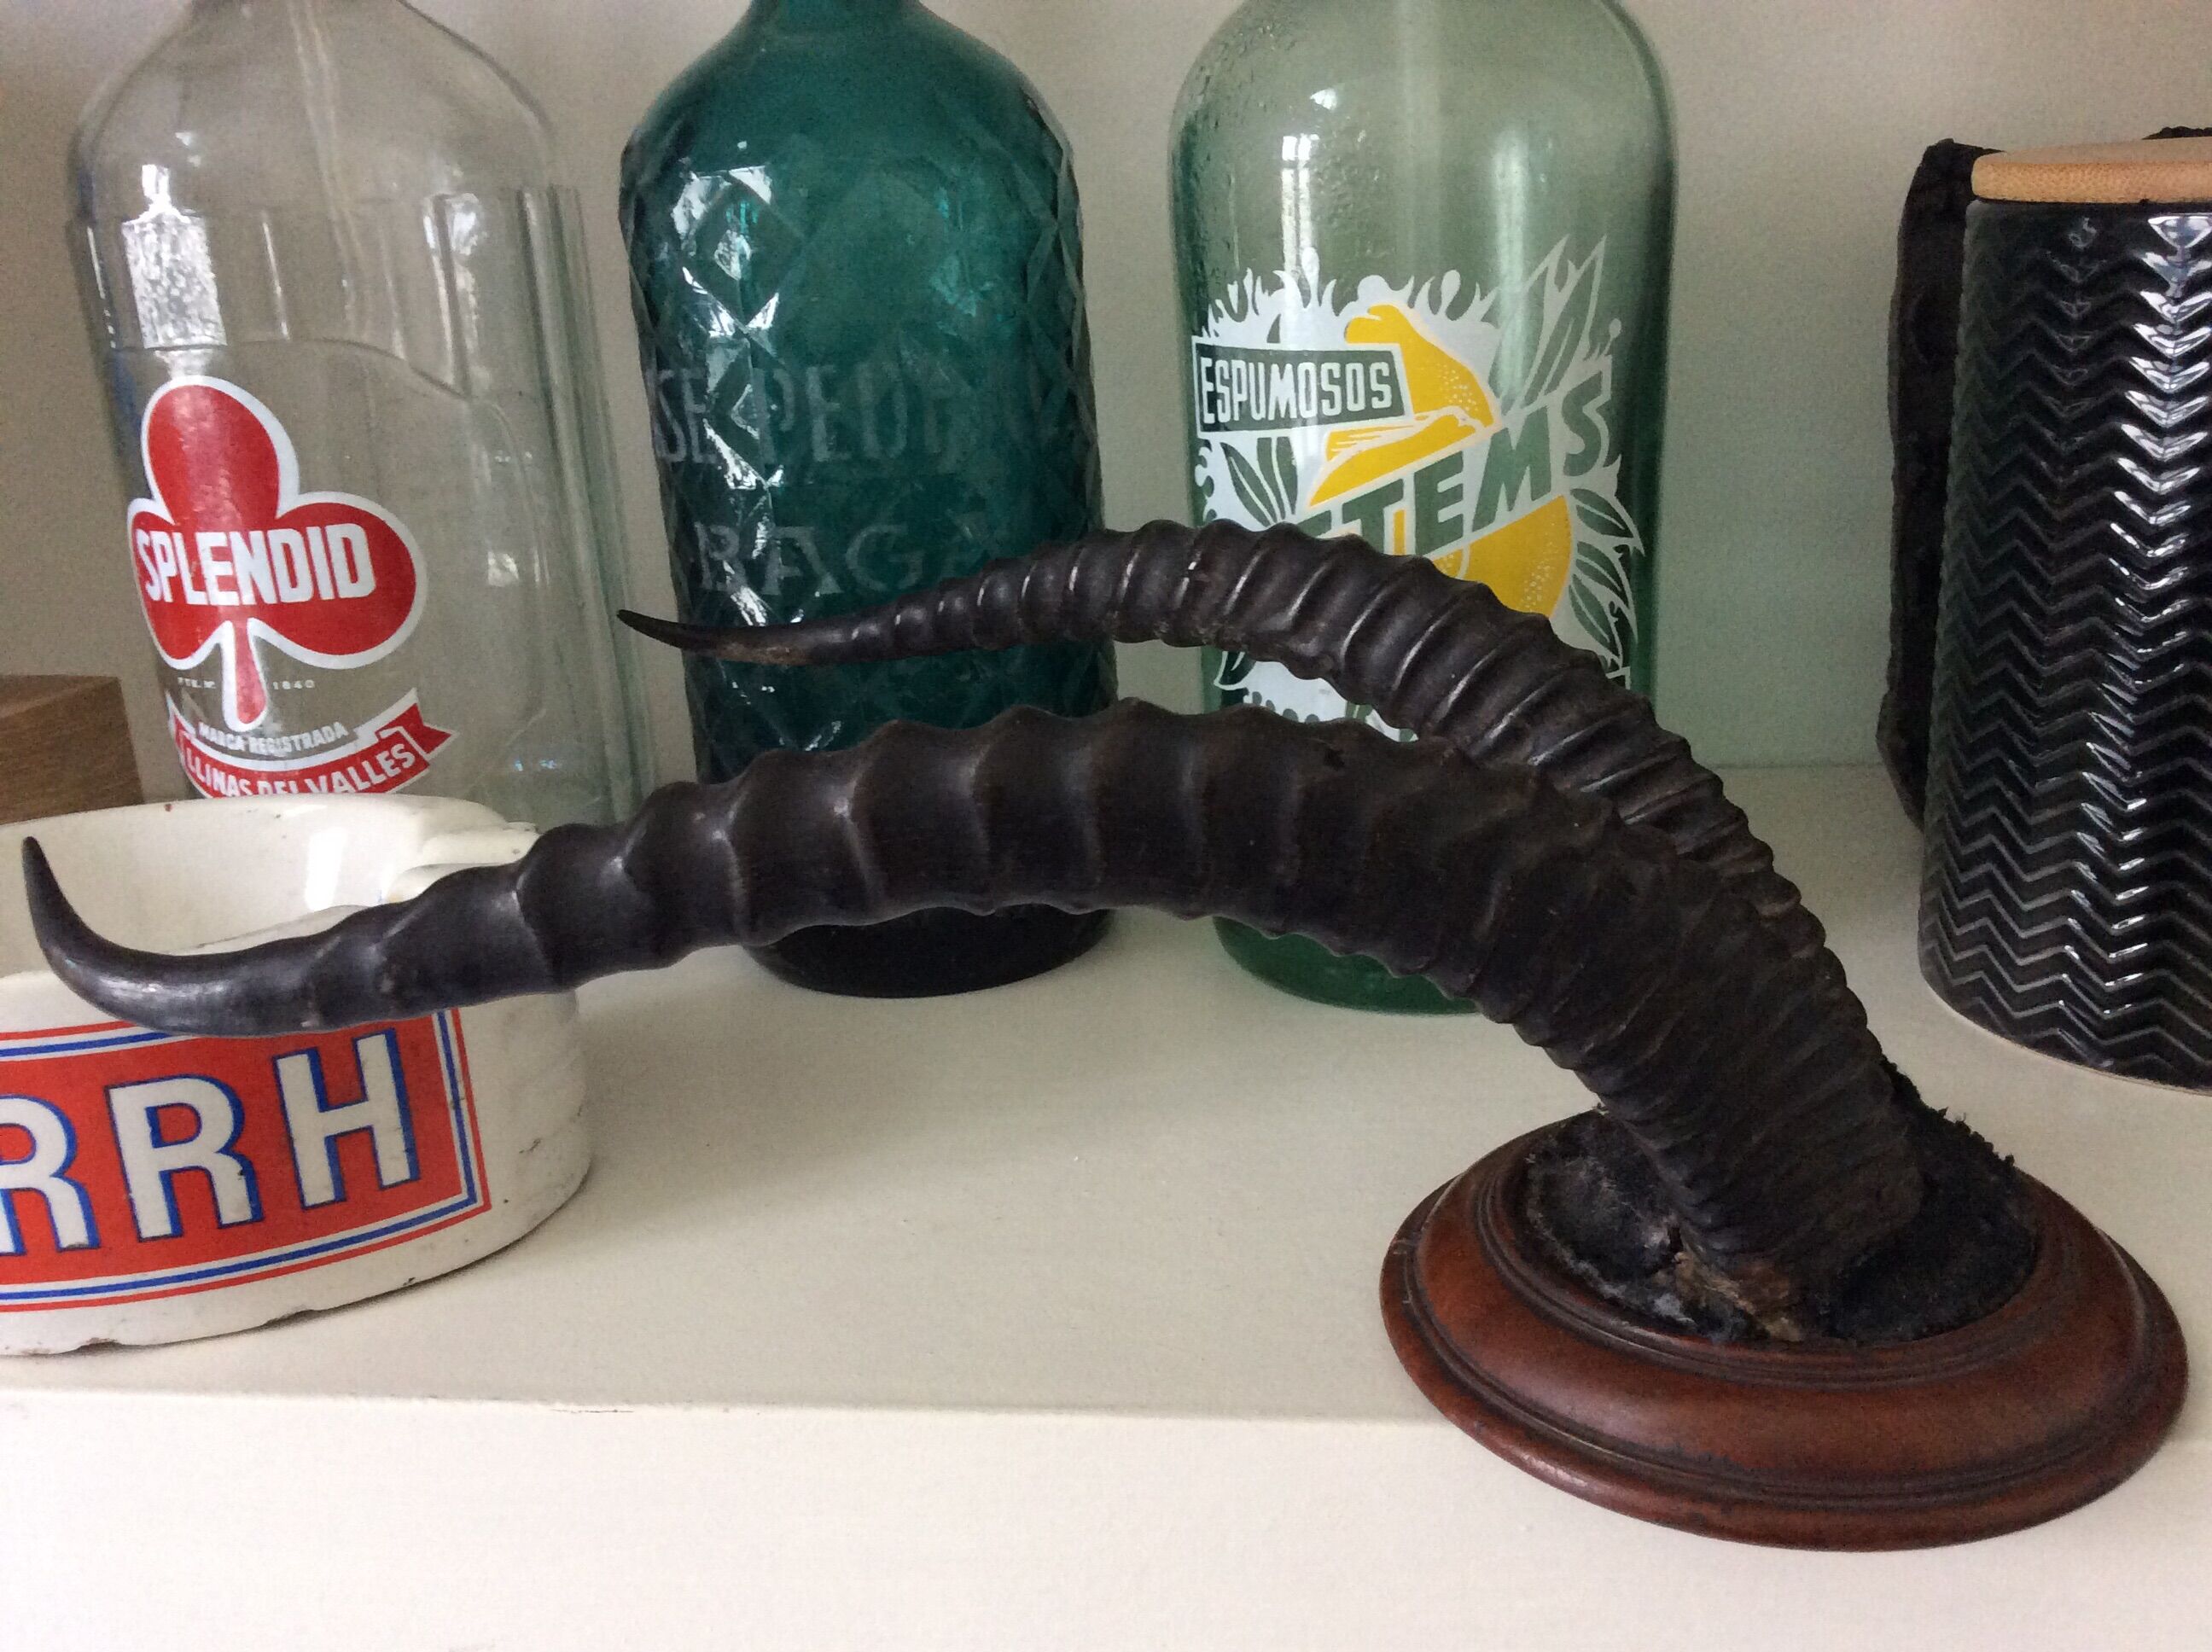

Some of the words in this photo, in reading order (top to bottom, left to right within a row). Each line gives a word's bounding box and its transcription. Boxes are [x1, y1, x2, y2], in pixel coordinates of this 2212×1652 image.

[1200, 357, 1393, 425] ESPUMOSOS
[136, 523, 376, 607] SPLENDID
[197, 721, 246, 752] MARCA
[247, 721, 350, 757] REGISTRADA
[304, 742, 416, 794] VALLES
[0, 1027, 421, 1257] RRH
